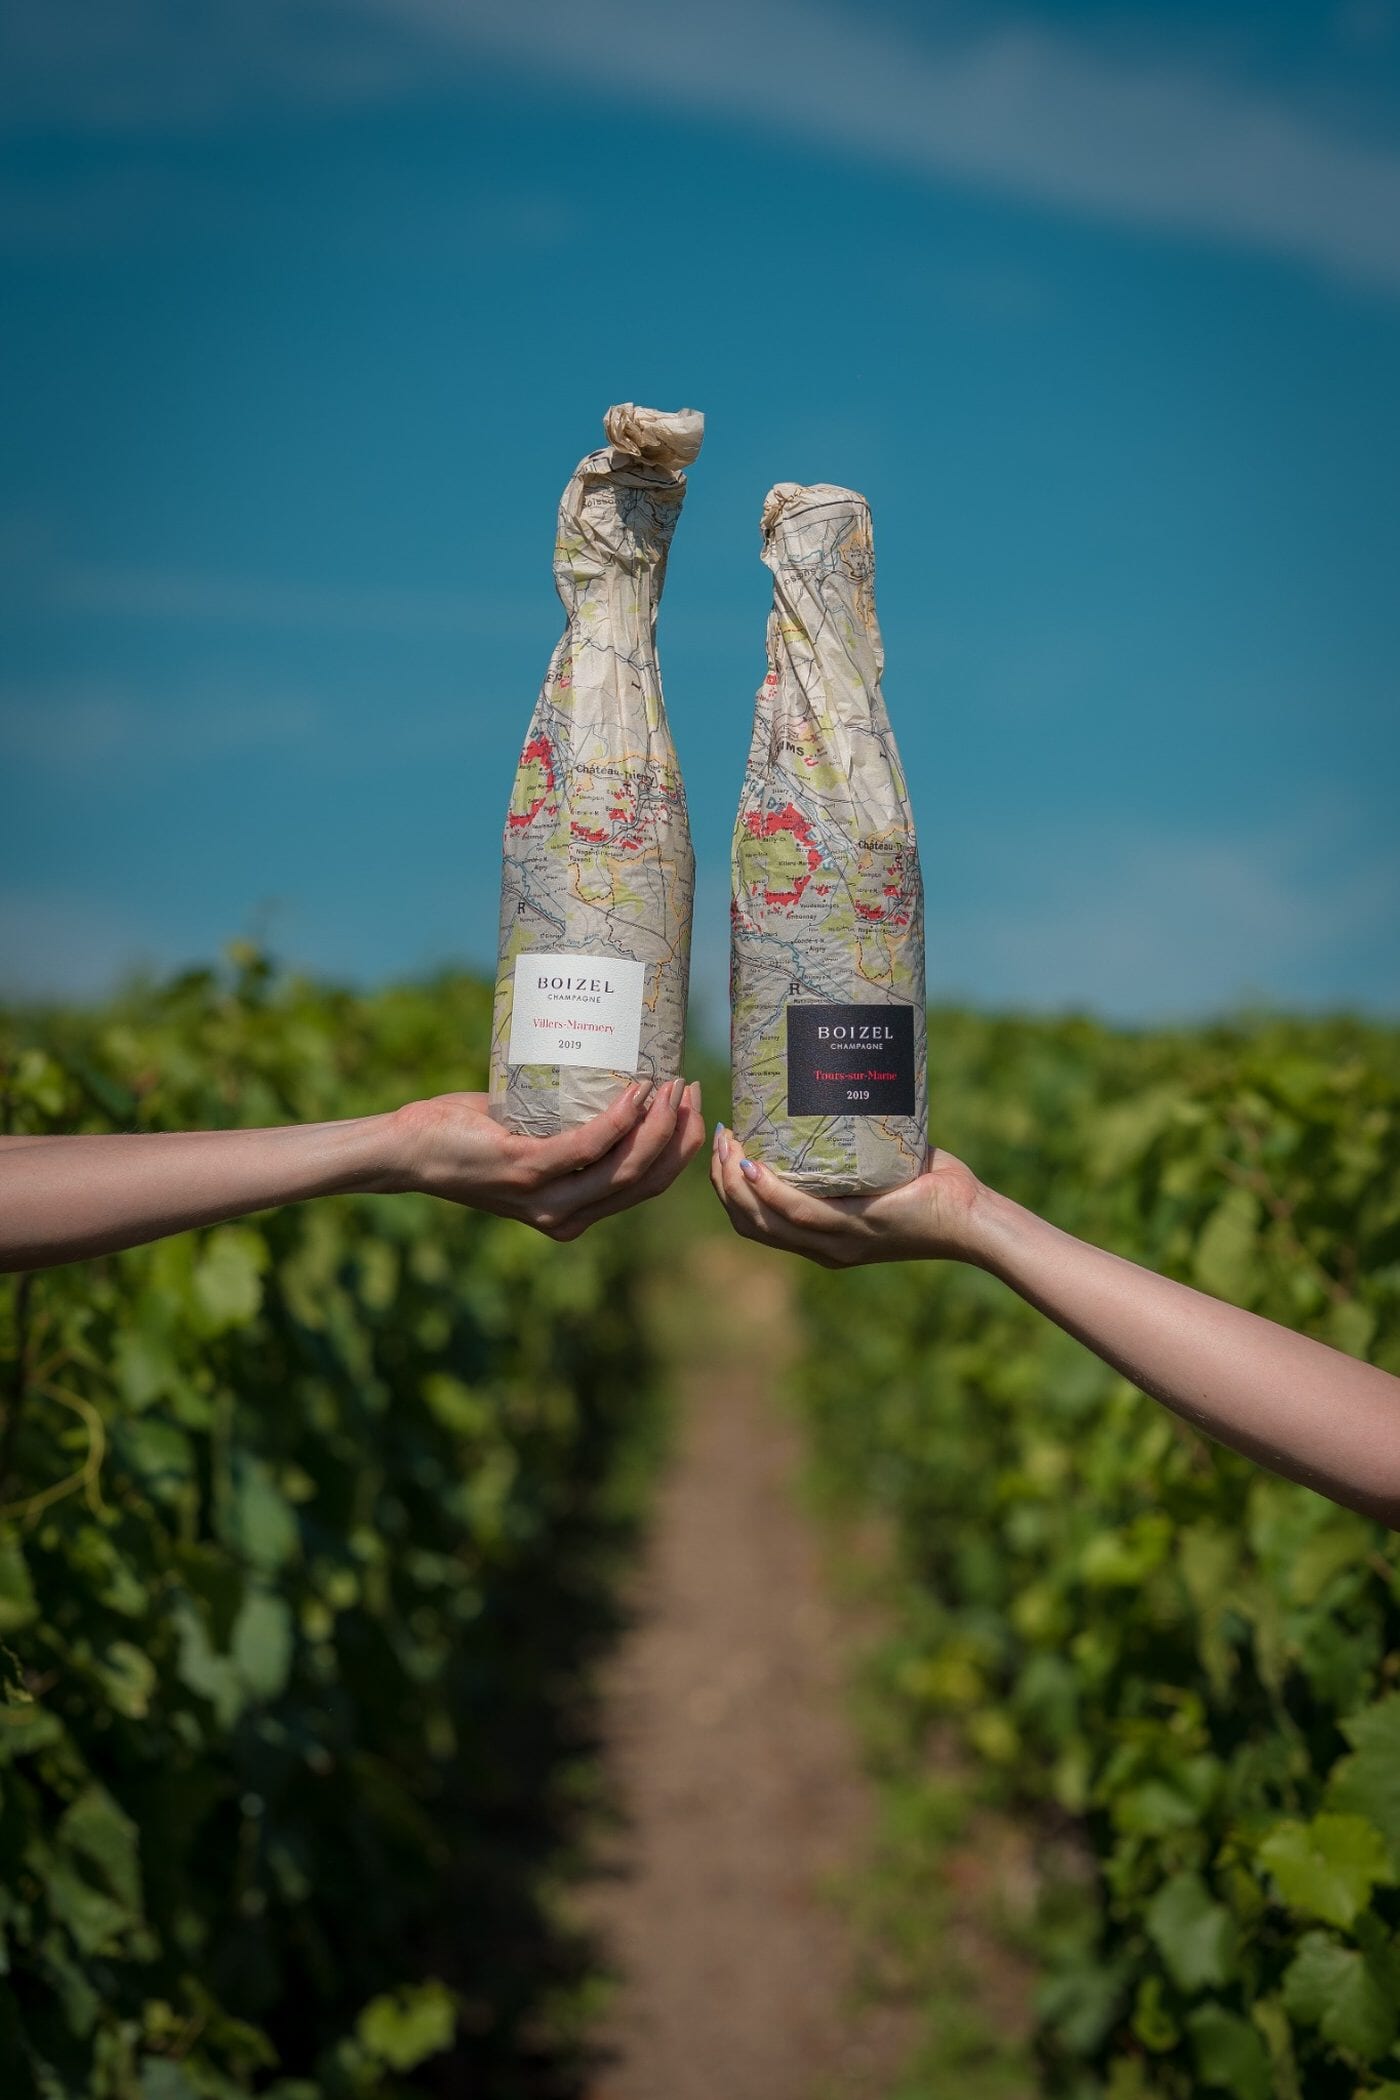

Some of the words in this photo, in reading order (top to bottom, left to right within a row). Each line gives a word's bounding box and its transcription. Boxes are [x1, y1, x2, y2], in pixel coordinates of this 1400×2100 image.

[517, 901, 526, 914] R
[538, 976, 615, 994] BOIZEL
[788, 983, 800, 996] R
[547, 993, 602, 1004] CHAMPAGNE
[532, 1018, 616, 1036] Villers-Marmery
[818, 1026, 894, 1040] BOIZEL
[558, 1039, 582, 1050] 2019
[814, 1069, 898, 1081] Tours-sur-Marne
[846, 1090, 870, 1100] 2019
